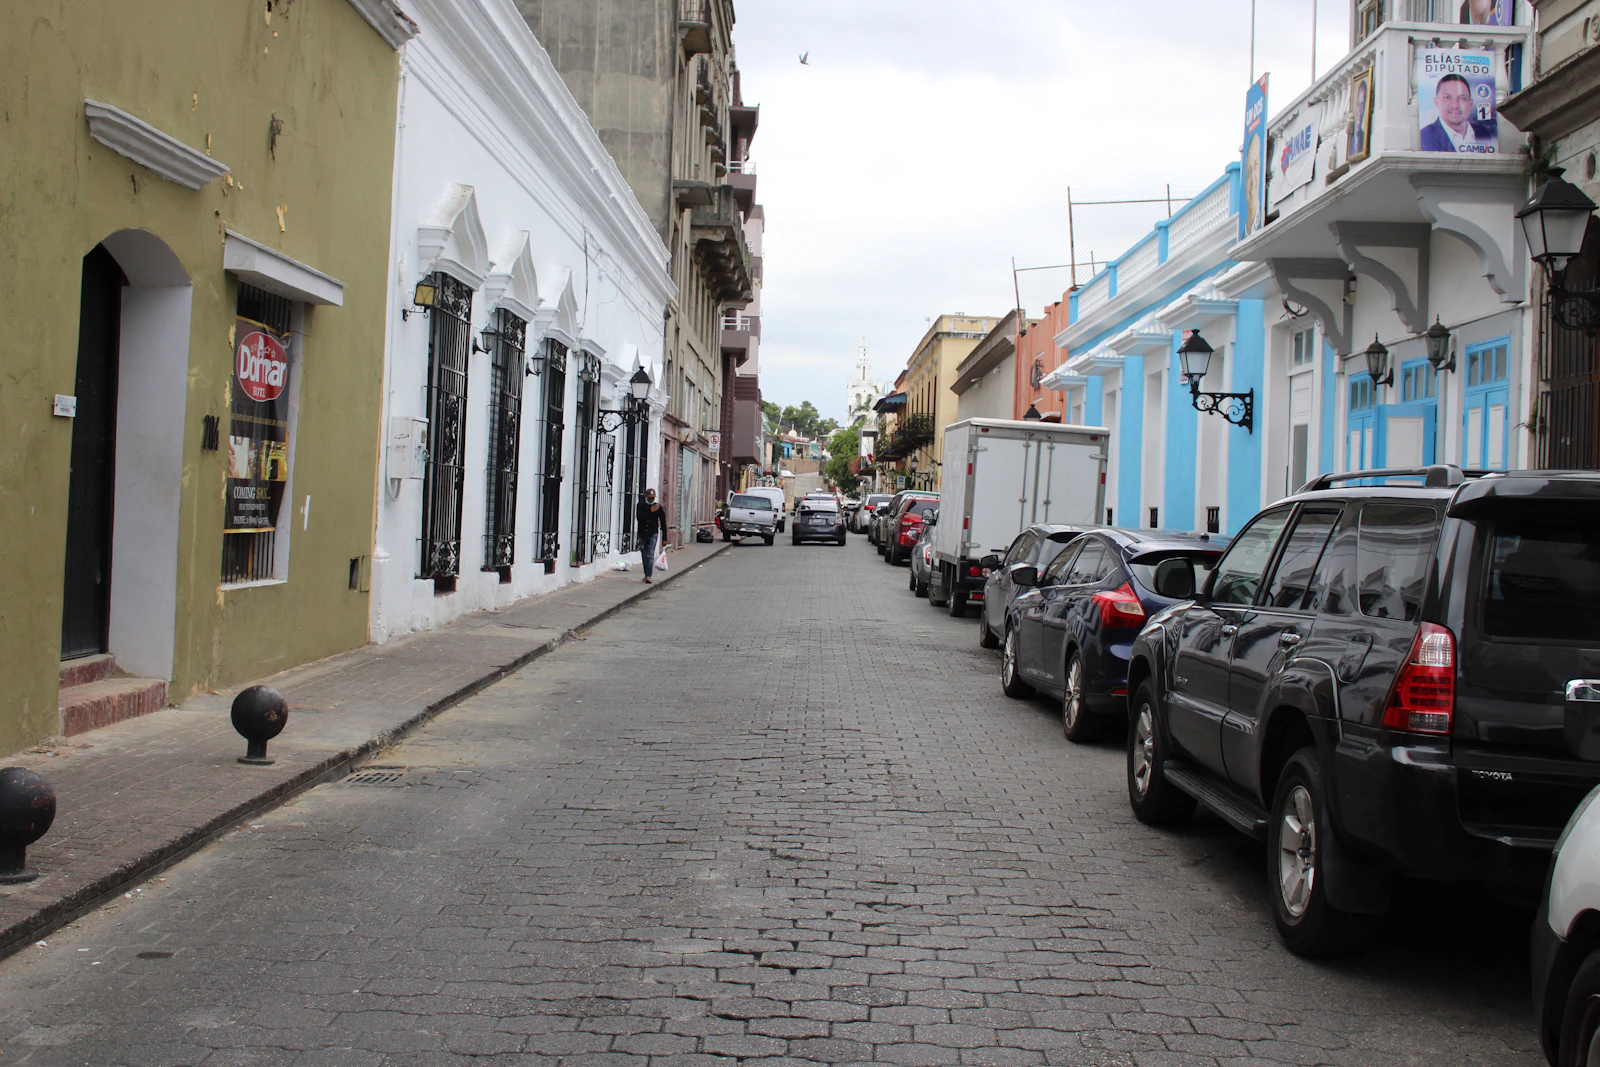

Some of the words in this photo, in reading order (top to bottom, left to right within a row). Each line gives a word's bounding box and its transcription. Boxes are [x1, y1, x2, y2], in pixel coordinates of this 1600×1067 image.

[1425, 53, 1460, 64] ELÍAS
[1425, 64, 1489, 75] DIPUTADO
[1459, 144, 1496, 154] CAMBIO
[240, 344, 287, 388] Domar
[233, 486, 256, 499] COMING
[1471, 769, 1513, 781] TOYOTA
